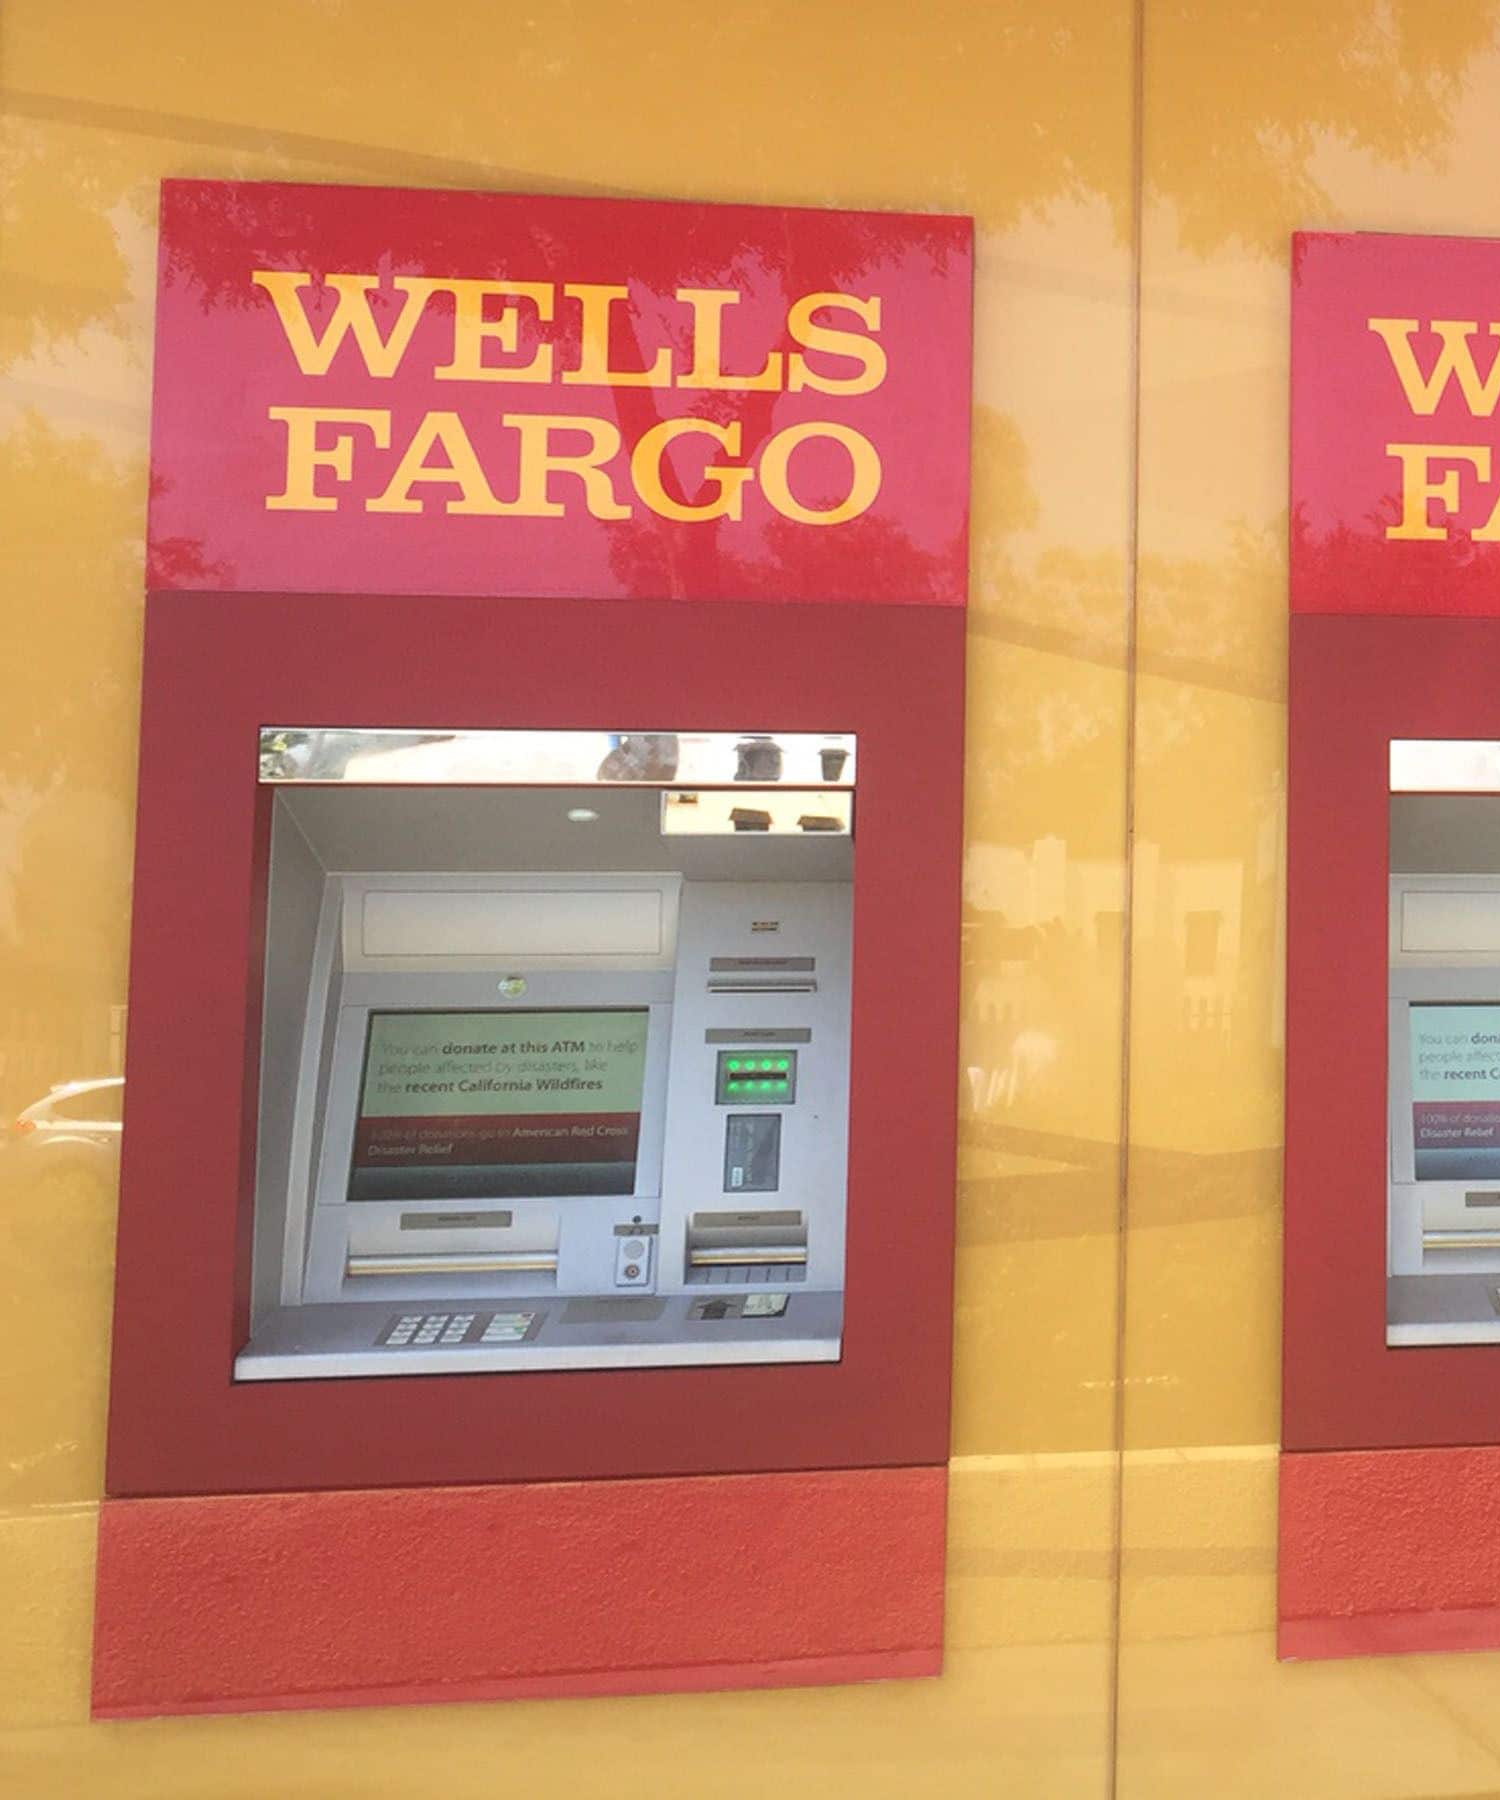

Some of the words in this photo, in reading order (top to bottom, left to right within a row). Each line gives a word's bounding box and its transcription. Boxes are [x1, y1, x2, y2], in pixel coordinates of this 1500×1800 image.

[253, 271, 887, 396] WELLS
[265, 406, 882, 525] FARGO
[441, 1041, 497, 1055] donate
[501, 1043, 516, 1054] at
[519, 1040, 548, 1053] this
[551, 1040, 585, 1053] ATM
[584, 1057, 608, 1072] like
[1444, 1069, 1488, 1080] recent
[405, 1081, 454, 1093] recent
[458, 1078, 533, 1092] California
[536, 1077, 603, 1091] Wildfires
[512, 1127, 569, 1138] American
[571, 1125, 595, 1137] Red
[596, 1125, 629, 1137] Cross
